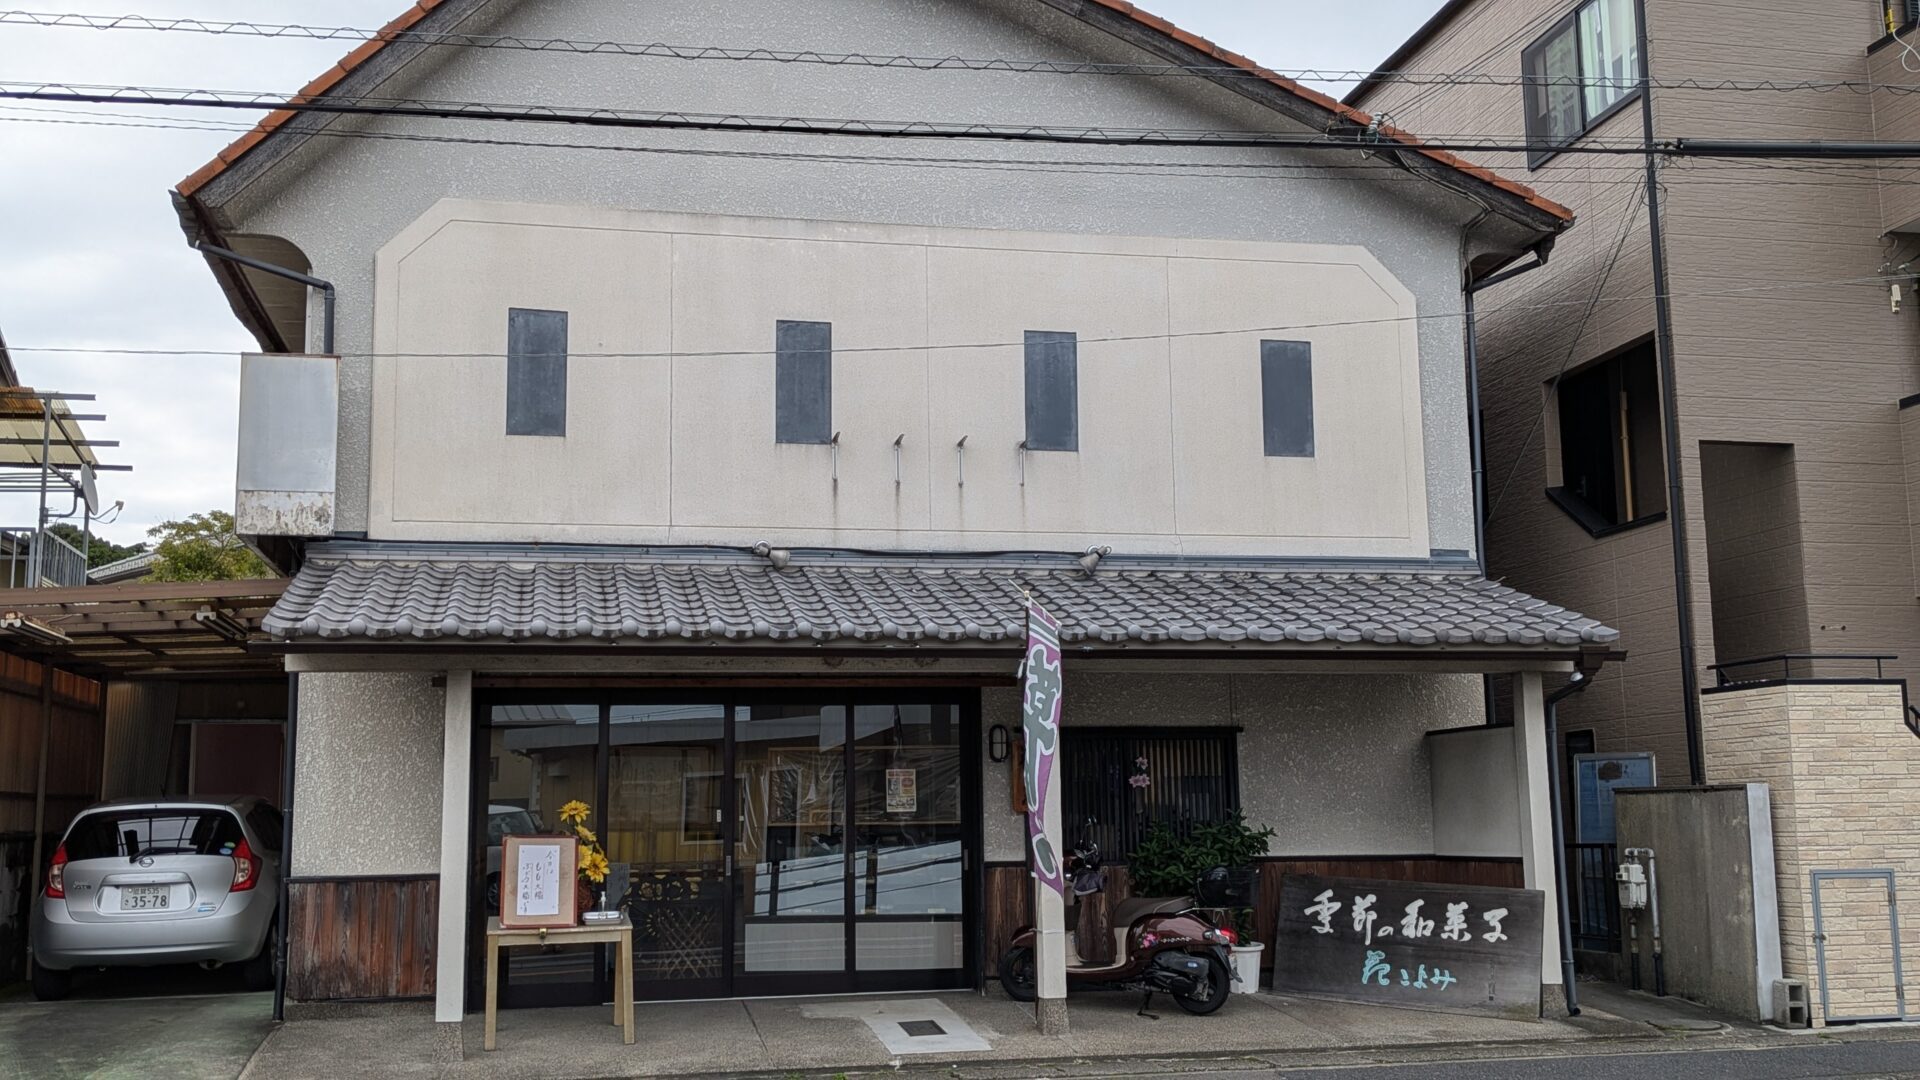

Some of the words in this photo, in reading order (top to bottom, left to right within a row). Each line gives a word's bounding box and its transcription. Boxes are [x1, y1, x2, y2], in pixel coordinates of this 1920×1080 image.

[131, 895, 167, 908] 35-78
[1304, 889, 1509, 945] 季節の和菓子
